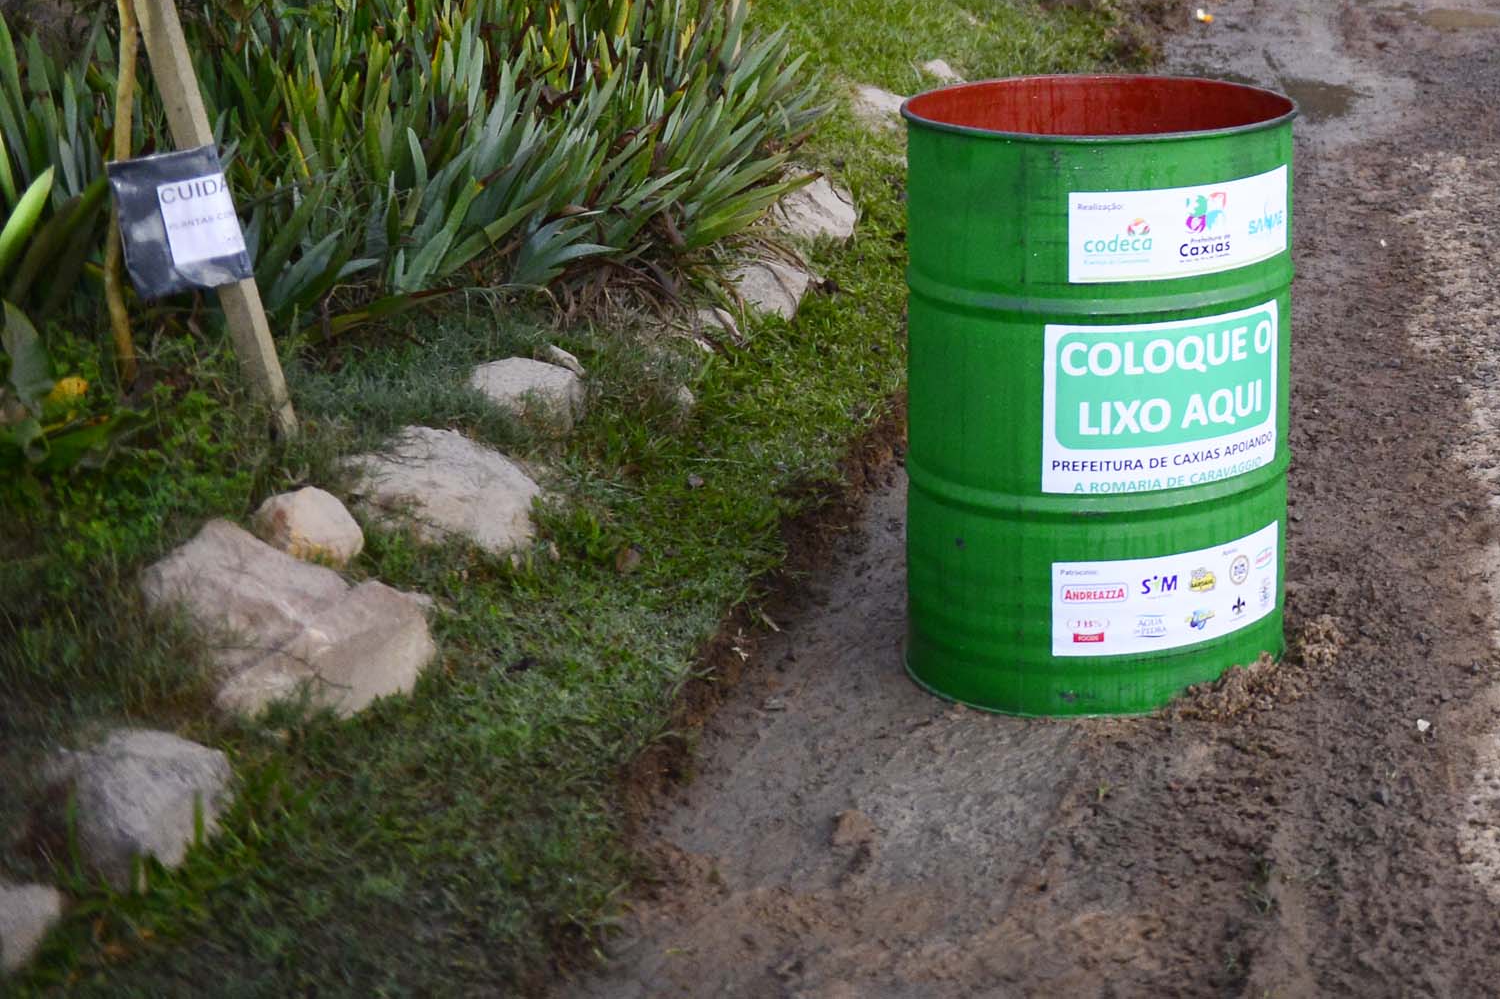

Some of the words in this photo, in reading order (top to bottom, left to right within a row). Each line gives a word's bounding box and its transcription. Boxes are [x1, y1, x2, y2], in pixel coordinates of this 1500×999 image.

[1083, 234, 1152, 253] codeca
[1179, 240, 1231, 257] Caxias
[1060, 326, 1248, 377] COLOQUE
[1253, 320, 1272, 355] O
[1079, 398, 1172, 436] LIXO
[1181, 379, 1262, 429] AQUI
[1052, 458, 1144, 472] PREFEITURA
[1149, 456, 1168, 469] DE
[1173, 448, 1221, 466] CAXIAS
[1224, 431, 1273, 458] APOIANDO
[1073, 482, 1084, 492] A
[1089, 477, 1162, 493] ROMARIA
[1166, 475, 1185, 488] DE
[1190, 456, 1262, 484] CARAVAGGIO
[1064, 588, 1125, 600] ANDREAZZA
